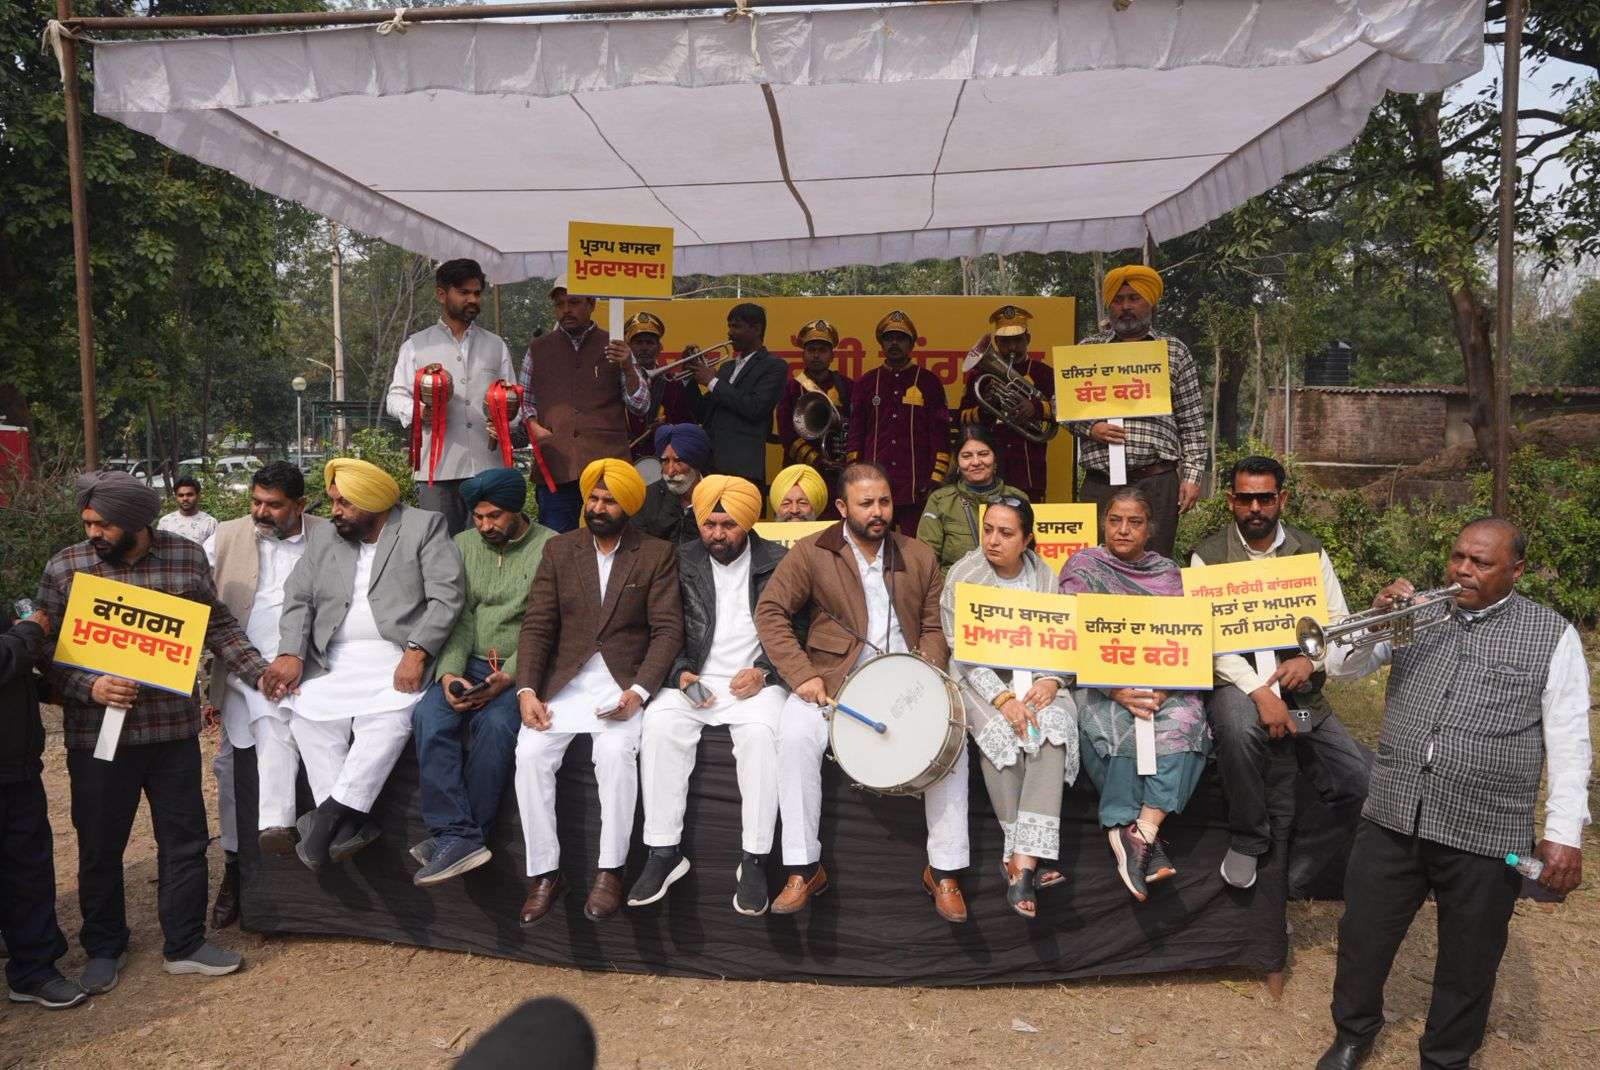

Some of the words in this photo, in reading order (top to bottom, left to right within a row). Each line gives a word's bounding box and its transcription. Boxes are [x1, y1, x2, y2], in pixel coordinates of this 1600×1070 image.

[619, 241, 661, 256] ਬਾਜਵਾ
[575, 259, 666, 280] ਮੁਰਦਾਬਾਦ!
[1061, 363, 1098, 379] ਦਲਿਤਾਂ
[1100, 365, 1115, 376] ਦਾ
[1117, 363, 1162, 375] ਅਪਮਾਨ
[1075, 381, 1108, 402] ਬੰਦ
[1112, 377, 1152, 401] ਕਰੋ!
[1036, 521, 1083, 535] ਬਾਜਵਾ
[1227, 580, 1264, 596] ਵਿਰੋਧੀ
[1266, 575, 1319, 591] ਕਾਂਗਰਸ!
[969, 602, 1014, 623] ਪ੍ਰਤਾਪ
[1018, 608, 1070, 625] ਬਾਜਵਾ
[1242, 601, 1259, 613] ਦਾ
[1262, 594, 1317, 610] ਅਪਮਾਨ
[93, 596, 185, 638] ਕਾਂਗਰਸ
[1085, 618, 1127, 634] ਦਲਿਤਾਂ
[1131, 622, 1146, 635] ਦਾ
[1150, 623, 1203, 636] ਅਪਮਾਨ
[1220, 616, 1249, 637] ਨਹੀਂ
[73, 618, 193, 665] ਮੁਰਦਾਬਾਦ!
[1099, 637, 1136, 666] ਬੰਦ
[1142, 638, 1189, 667] ਕਰੋ!
